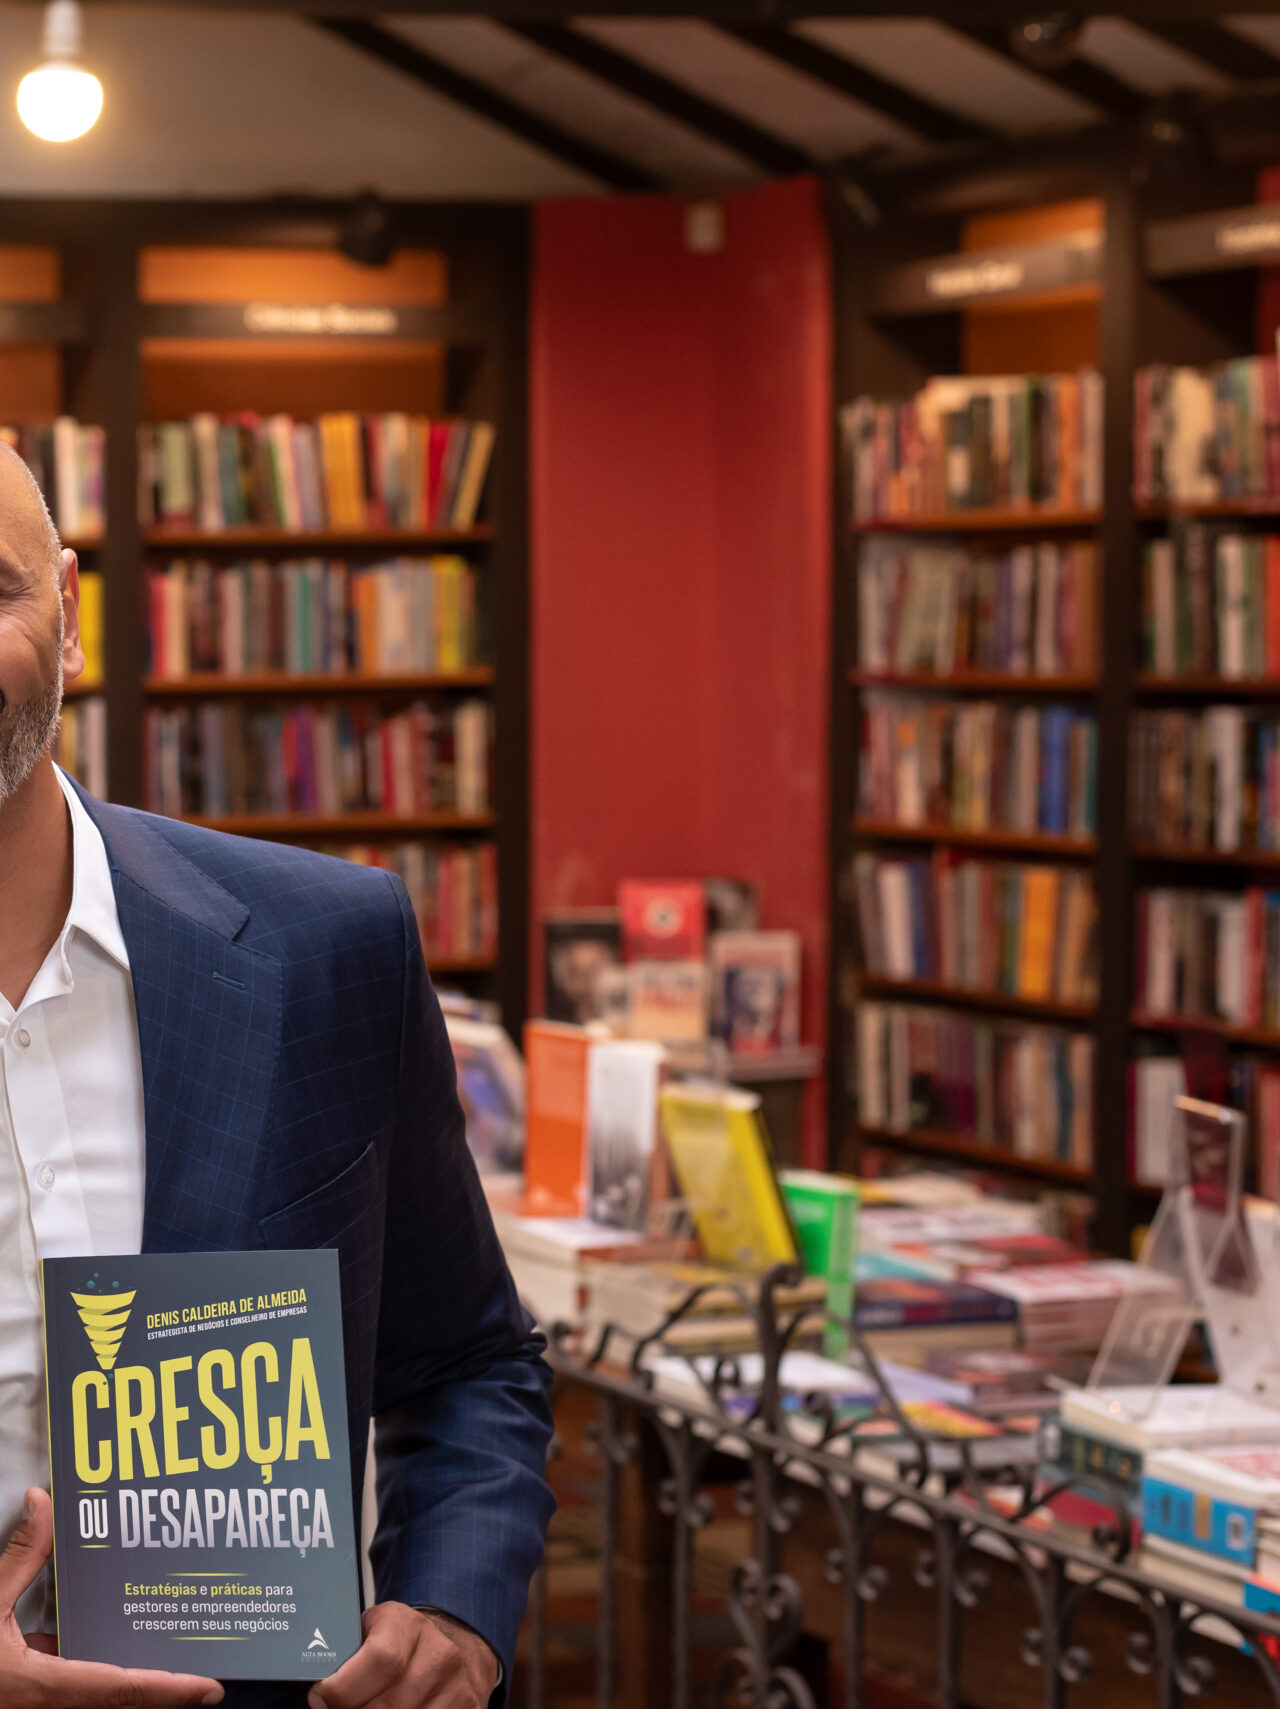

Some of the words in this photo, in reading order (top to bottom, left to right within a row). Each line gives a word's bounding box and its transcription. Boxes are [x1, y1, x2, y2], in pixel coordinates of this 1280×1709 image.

[147, 1310, 179, 1329] DENIS
[182, 1301, 237, 1323] CALDEIRA
[240, 1297, 254, 1312] DE
[257, 1288, 307, 1309] ALMEIDA
[148, 1327, 187, 1340] ESTRATEGISTA
[189, 1325, 196, 1333] DE
[198, 1320, 224, 1331] NEGÓCIOS
[230, 1312, 267, 1325] CONSELHEIRO
[269, 1311, 276, 1319] DE
[278, 1306, 307, 1318] EMPRESAS
[72, 1337, 330, 1484] CRESÇA
[79, 1498, 108, 1539] OU
[119, 1488, 334, 1558] DESAPAREÇA
[124, 1582, 197, 1597] Estratégias
[200, 1586, 207, 1595] e
[210, 1583, 262, 1597] práticas
[265, 1585, 293, 1597] para
[123, 1601, 178, 1615] gestores
[181, 1603, 189, 1612] e
[192, 1600, 296, 1614] empreendedores
[133, 1620, 199, 1630] crescerem
[202, 1620, 231, 1630] seus
[234, 1618, 289, 1632] negócios
